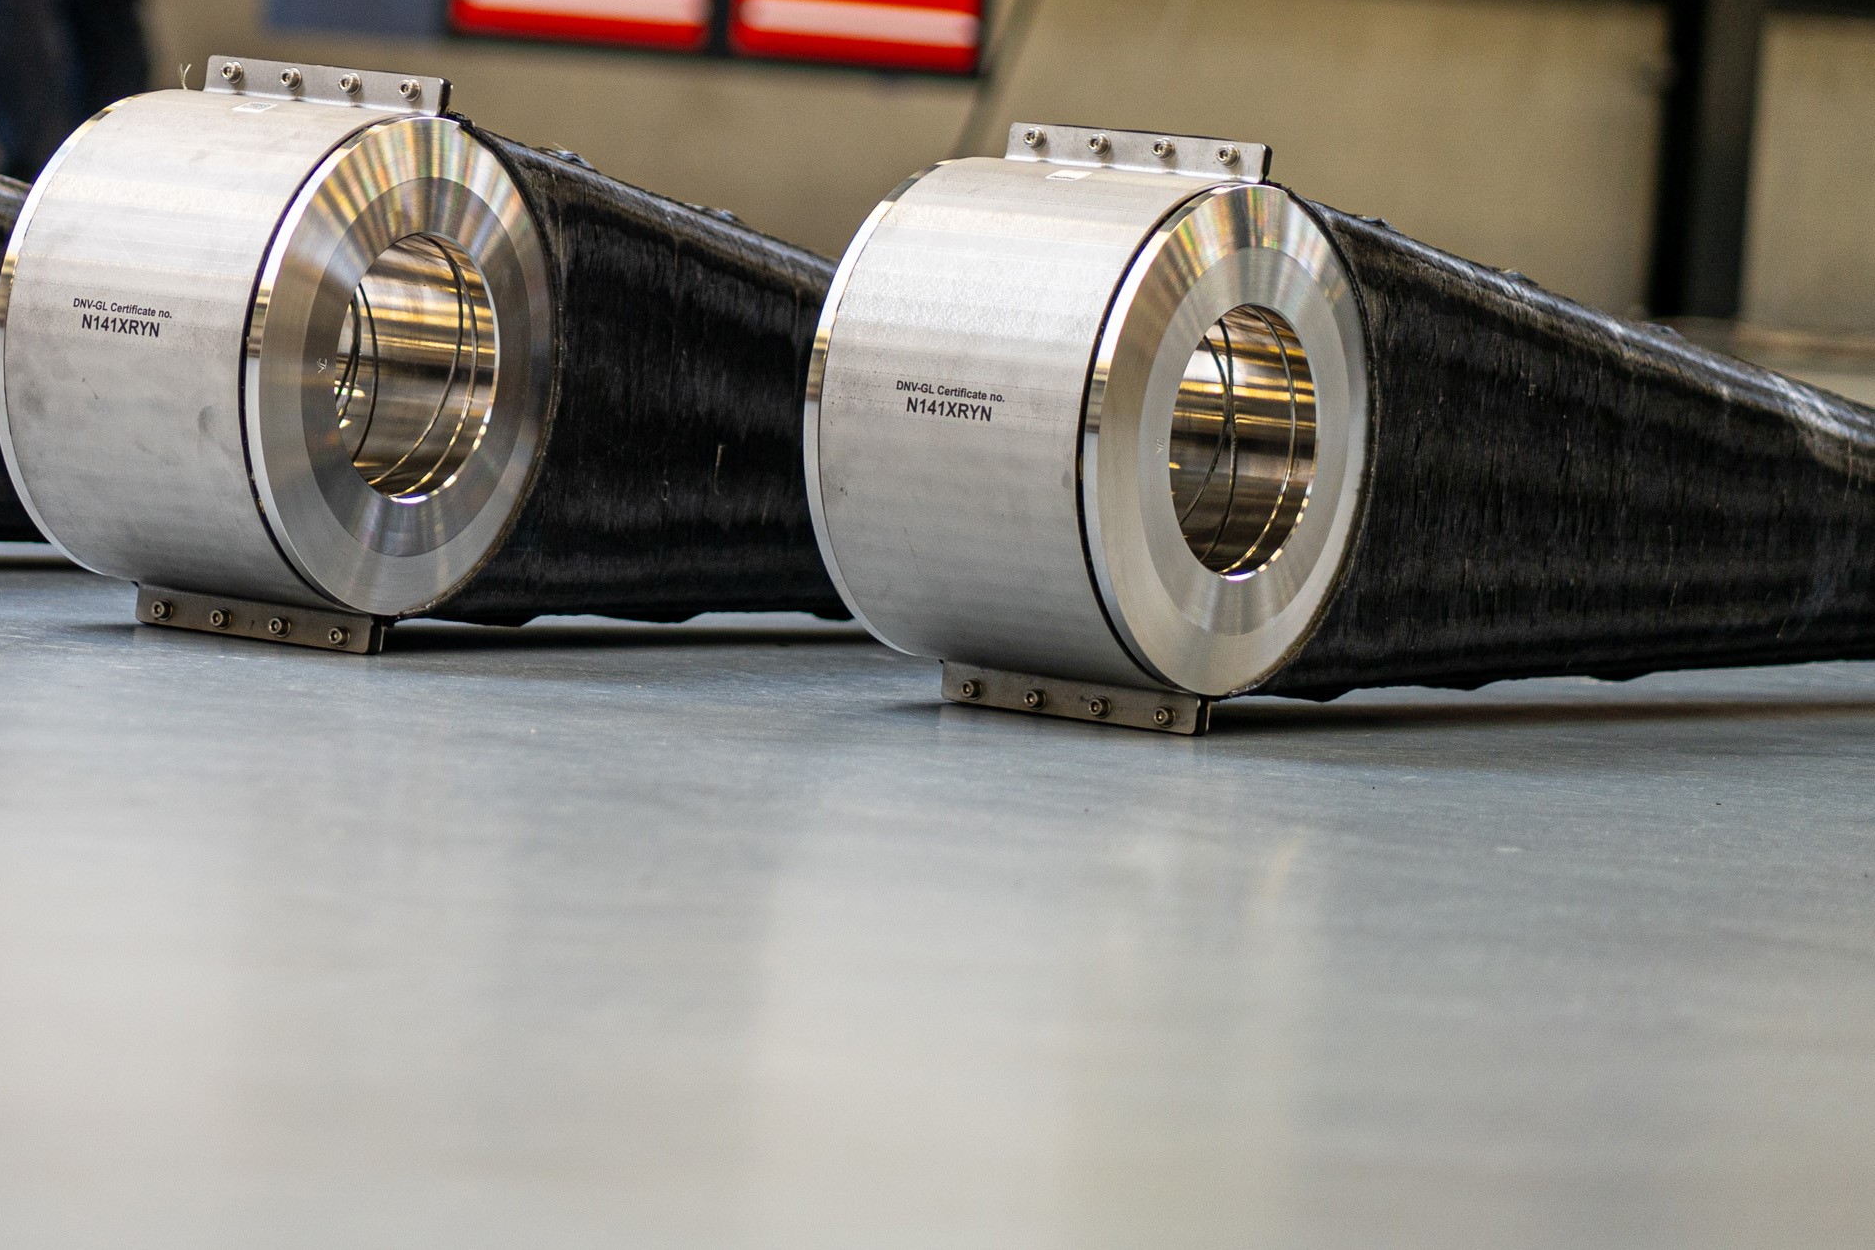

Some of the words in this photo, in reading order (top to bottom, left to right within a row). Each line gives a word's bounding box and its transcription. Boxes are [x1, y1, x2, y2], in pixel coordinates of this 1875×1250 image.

[72, 298, 108, 311] DNV-GL
[110, 302, 157, 317] Certificate
[158, 310, 172, 319] no.
[82, 314, 160, 338] N141XRYN
[895, 379, 934, 395] DNV-GL
[936, 385, 987, 401] Certificate
[989, 393, 1006, 403] no.
[907, 396, 992, 423] N141XRYN
